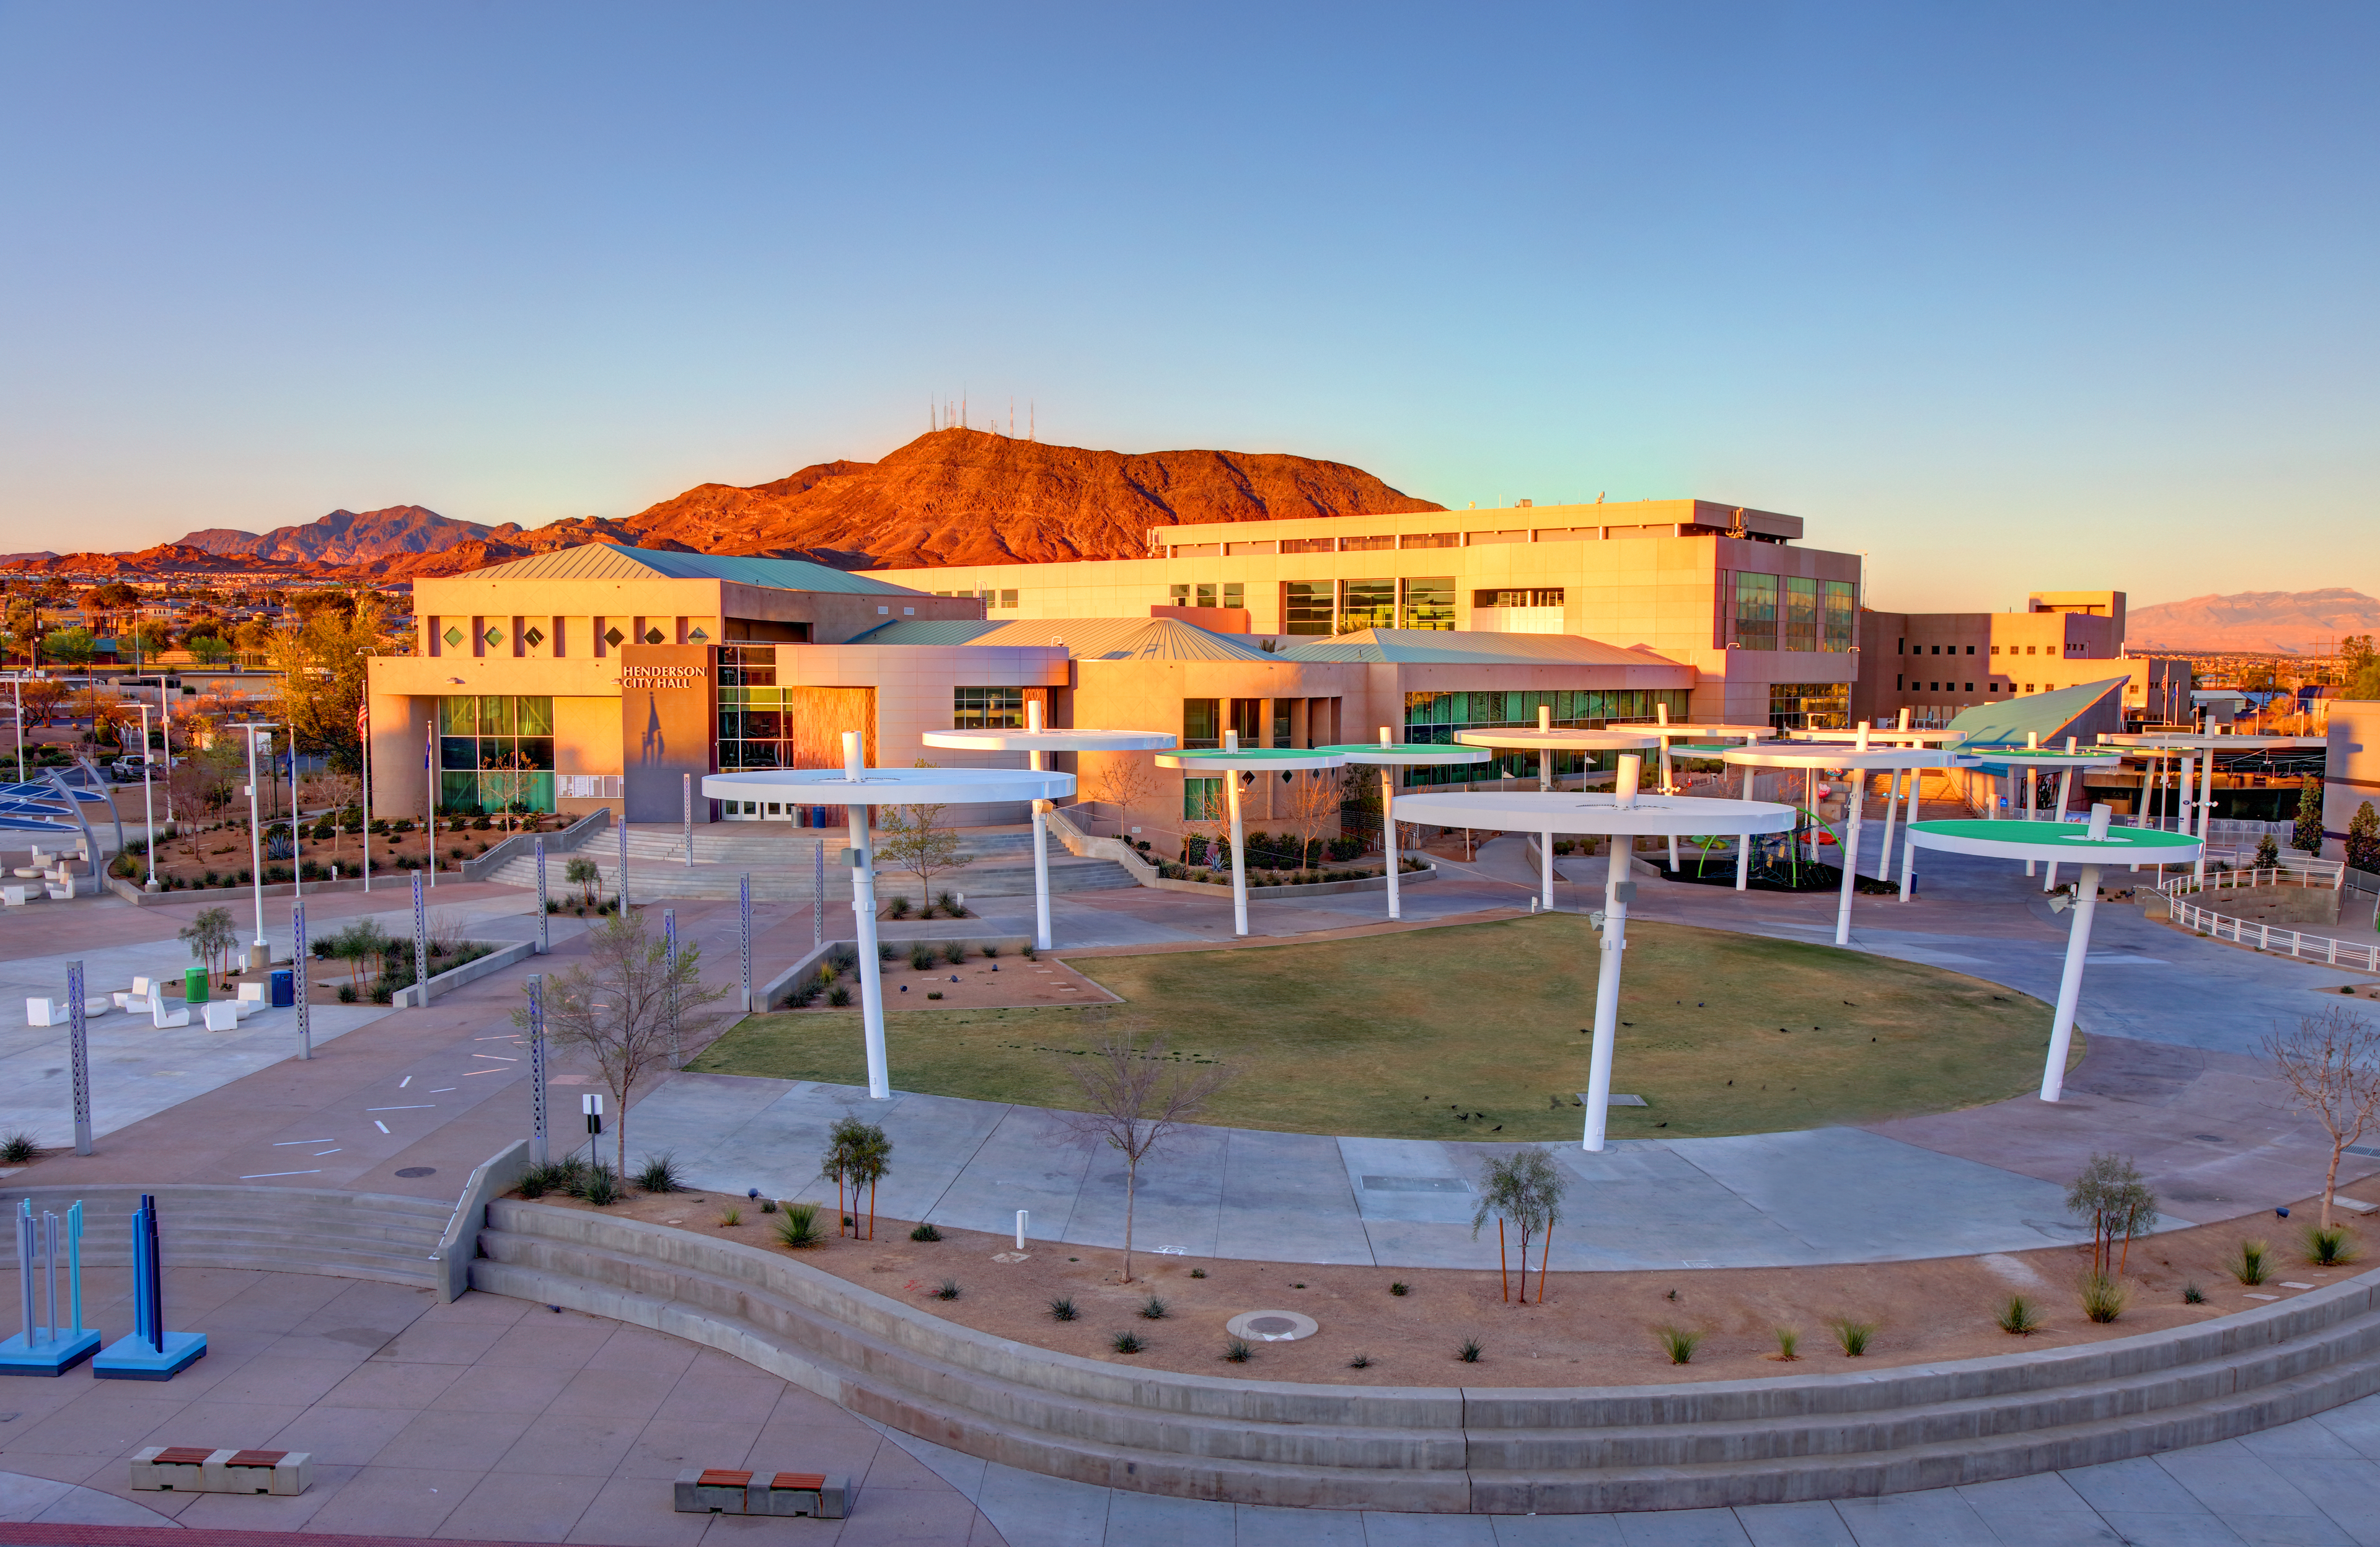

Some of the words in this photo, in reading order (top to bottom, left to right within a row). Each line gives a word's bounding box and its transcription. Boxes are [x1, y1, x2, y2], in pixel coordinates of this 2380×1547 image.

[624, 666, 705, 677] HENDERSON
[623, 678, 654, 689] CITY
[657, 678, 690, 689] HALL
